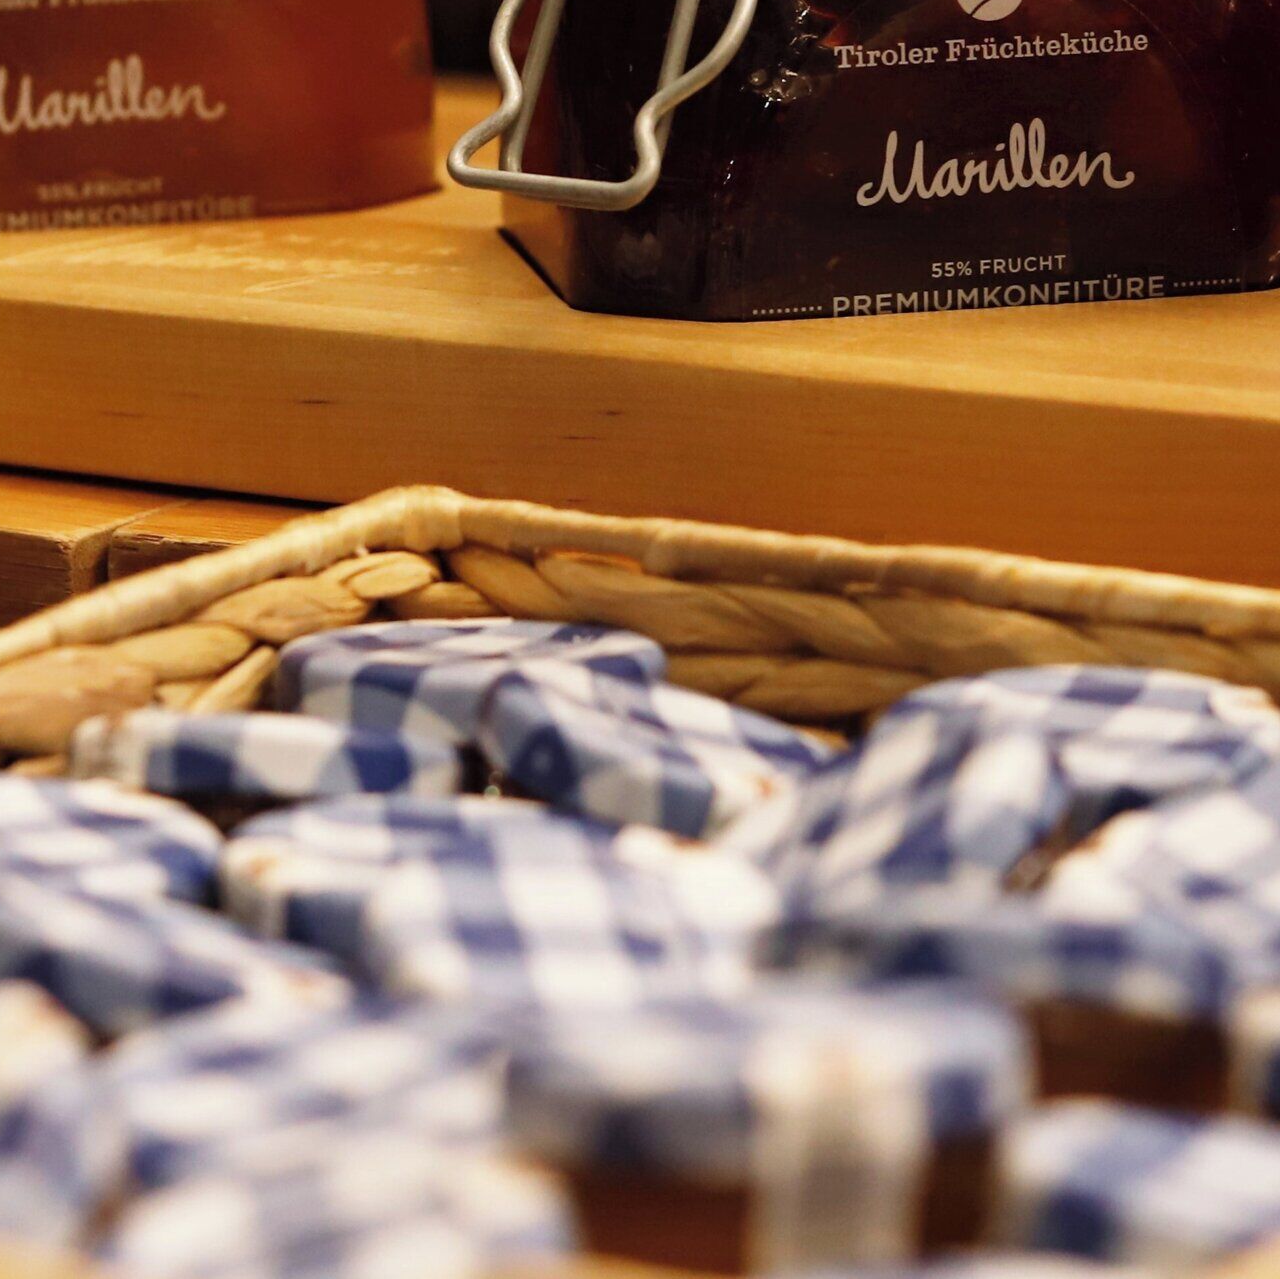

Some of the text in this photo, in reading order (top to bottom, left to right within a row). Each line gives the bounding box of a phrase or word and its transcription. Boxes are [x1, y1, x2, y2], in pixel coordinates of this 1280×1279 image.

[834, 29, 1150, 69] Tiroler Früchteküche
[856, 117, 1136, 207] Marillen
[931, 254, 1067, 279] 55% FRUCHT
[832, 273, 1166, 318] PREMIUMKONFITÜRE
